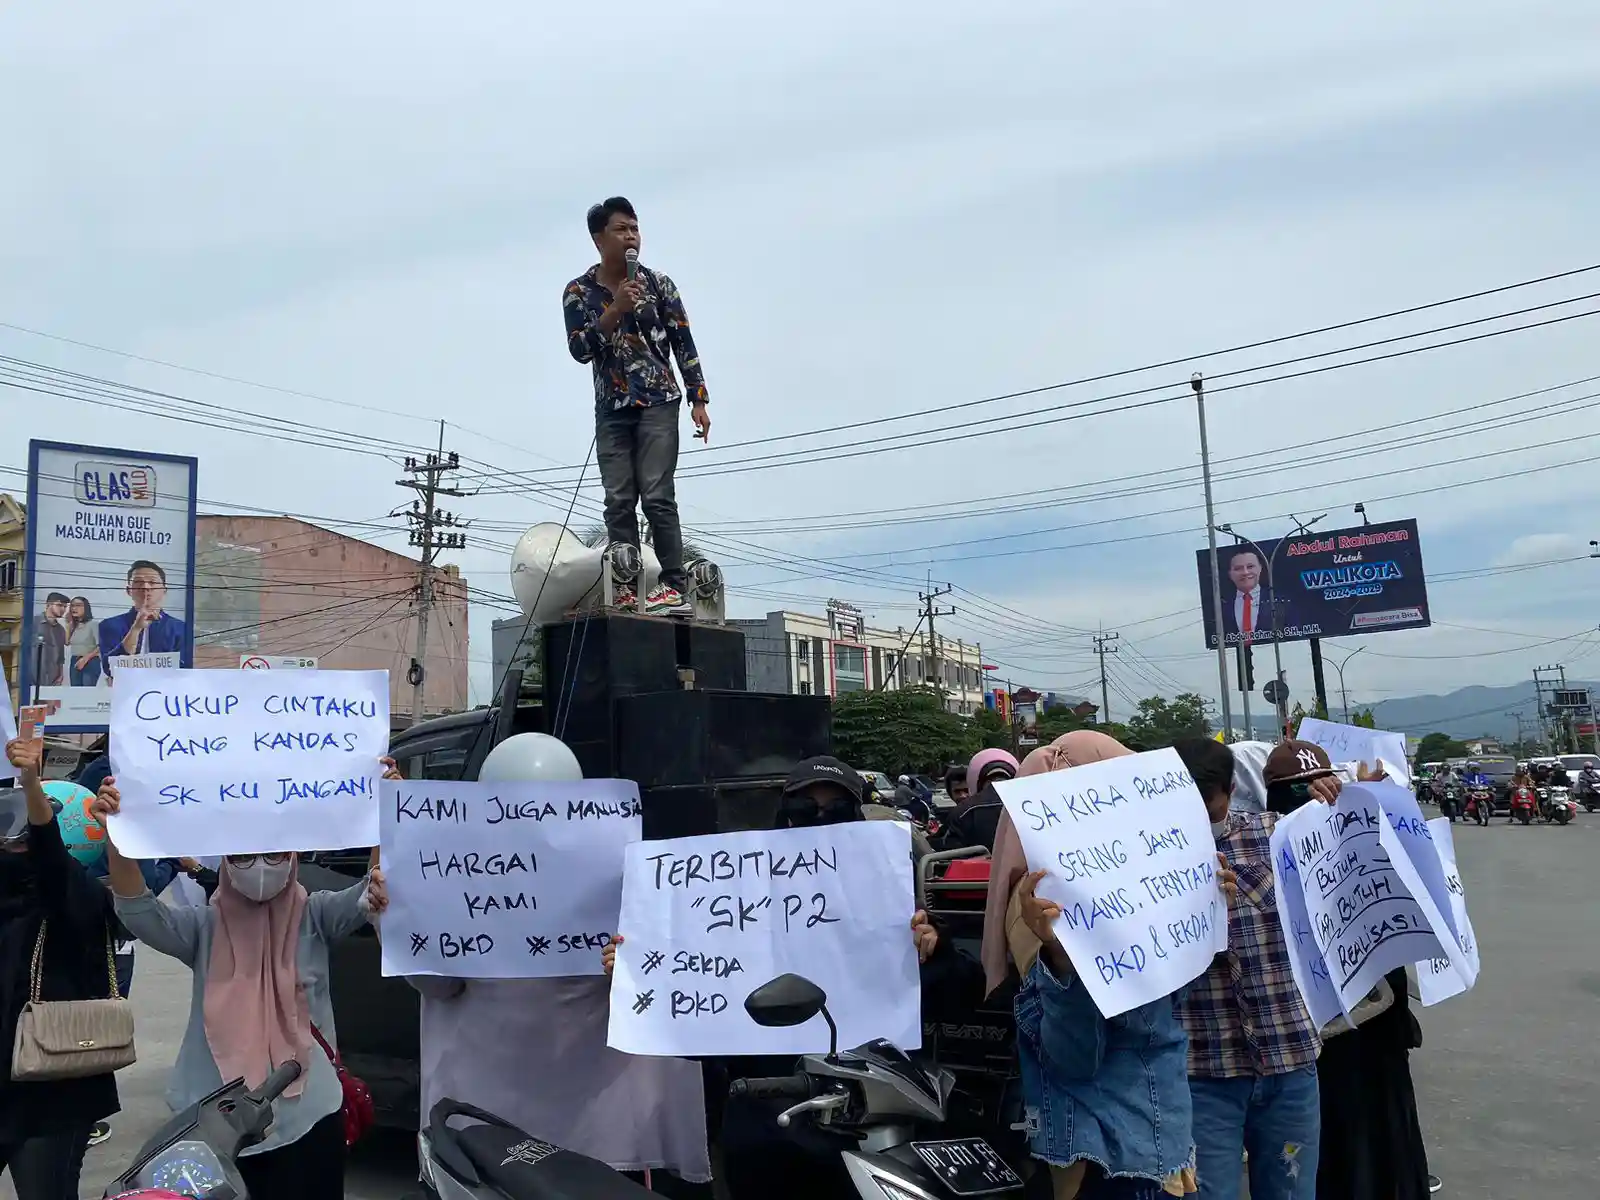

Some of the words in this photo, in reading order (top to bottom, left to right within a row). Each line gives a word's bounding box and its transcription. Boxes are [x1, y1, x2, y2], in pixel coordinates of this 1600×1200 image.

[83, 471, 131, 500] CLAS
[131, 470, 149, 500] MILD
[55, 524, 115, 541] MASALAH
[118, 530, 146, 545] BAGI
[149, 532, 172, 545] LO?
[75, 511, 123, 528] PILIHAN
[127, 516, 151, 530] GUE
[1287, 538, 1335, 556] Abdul
[1338, 529, 1408, 549] Rahman
[1333, 551, 1363, 563] Untuk
[1302, 560, 1402, 589] WALIKOTA
[1302, 623, 1321, 635] M.H.
[155, 655, 173, 669] GUE
[136, 690, 239, 721] CUKUP
[263, 694, 376, 718] CINTAKU
[147, 733, 227, 761] YANG
[254, 731, 357, 752] KANDAS
[1295, 748, 1321, 770] NY
[158, 784, 201, 805] SK
[219, 782, 259, 802] KU
[274, 776, 374, 805] JANGAN!
[395, 790, 467, 824] KAMI
[485, 796, 558, 824] JUGA
[1021, 799, 1062, 832] SA
[1061, 784, 1129, 822] KIRA
[1325, 807, 1381, 840] TIDAK
[418, 849, 538, 880] HARGAI
[645, 846, 838, 890] TERBITKAN
[1057, 839, 1129, 883] SERING
[1138, 828, 1190, 857] JANJI
[1139, 861, 1214, 905] TERNYATA
[1315, 851, 1359, 893] BUTUH
[463, 891, 538, 919] KAMI
[690, 894, 772, 935] "SK"
[1314, 912, 1336, 946] TAPI
[1336, 876, 1393, 924] BUTUH
[1094, 943, 1147, 986] BKD
[1148, 924, 1170, 961] &
[1336, 914, 1420, 977] REALISASI
[919, 1147, 947, 1168] DT
